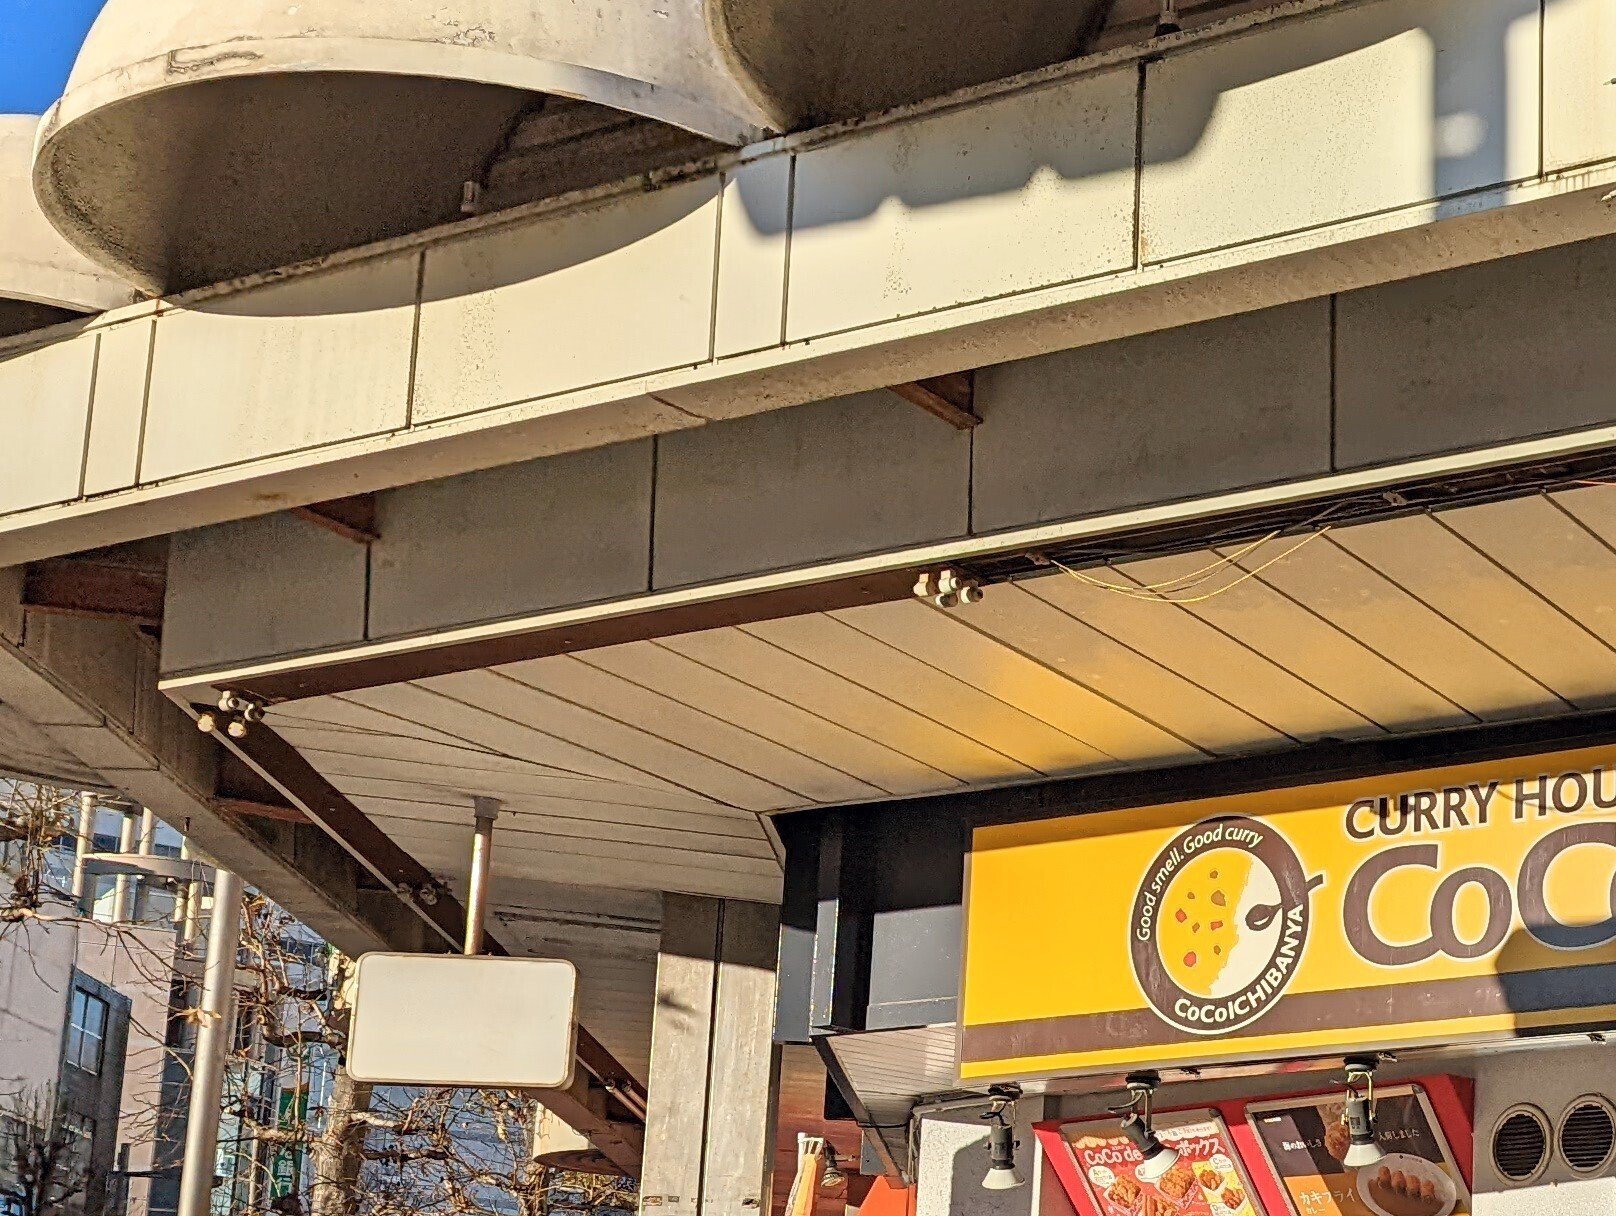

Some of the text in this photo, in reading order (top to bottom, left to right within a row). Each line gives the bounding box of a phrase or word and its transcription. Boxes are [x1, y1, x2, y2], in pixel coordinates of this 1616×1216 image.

[1345, 780, 1498, 840] CURRY
[1136, 823, 1264, 942] Good smell. Good curry
[1174, 903, 1304, 1023] CoCoICHIBANYA
[1084, 1146, 1123, 1165] CoCo
[1299, 1187, 1358, 1206] カキフライ
